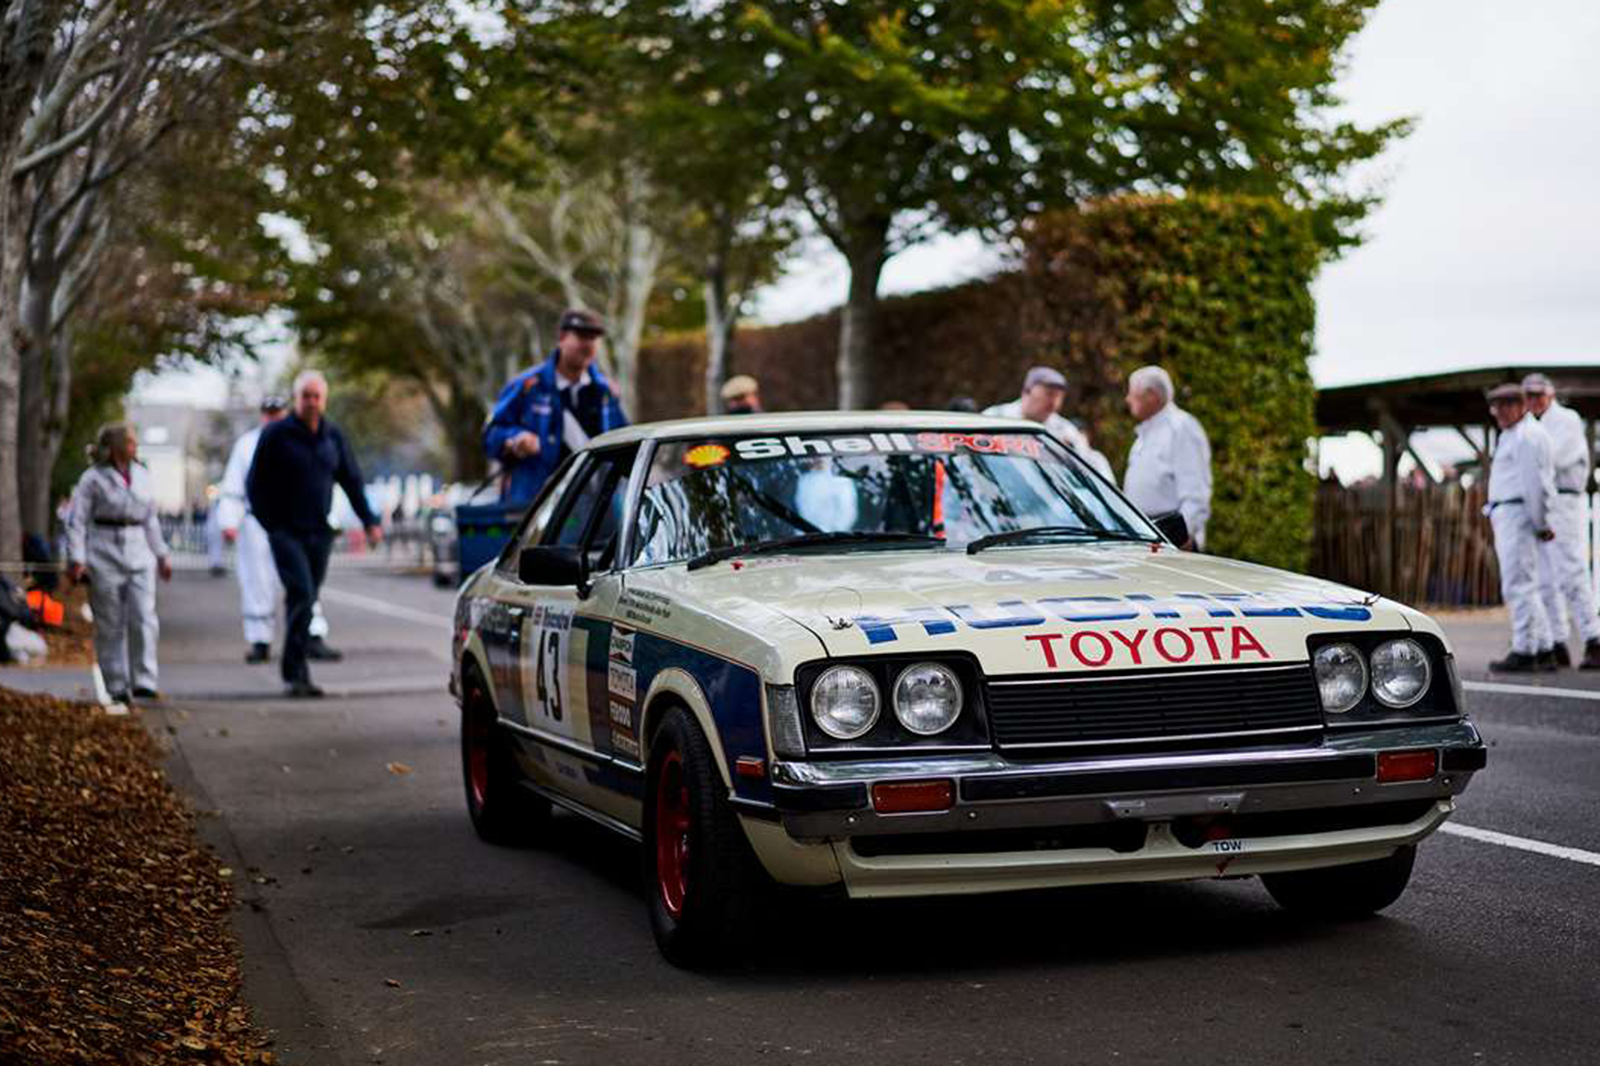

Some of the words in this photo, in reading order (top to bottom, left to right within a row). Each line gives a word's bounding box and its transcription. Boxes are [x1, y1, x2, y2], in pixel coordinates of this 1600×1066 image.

[735, 433, 913, 460] Shell
[917, 432, 1043, 457] SPORT
[1024, 625, 1270, 669] TOYOTA
[536, 629, 563, 722] 43
[1212, 840, 1241, 852] TOW
